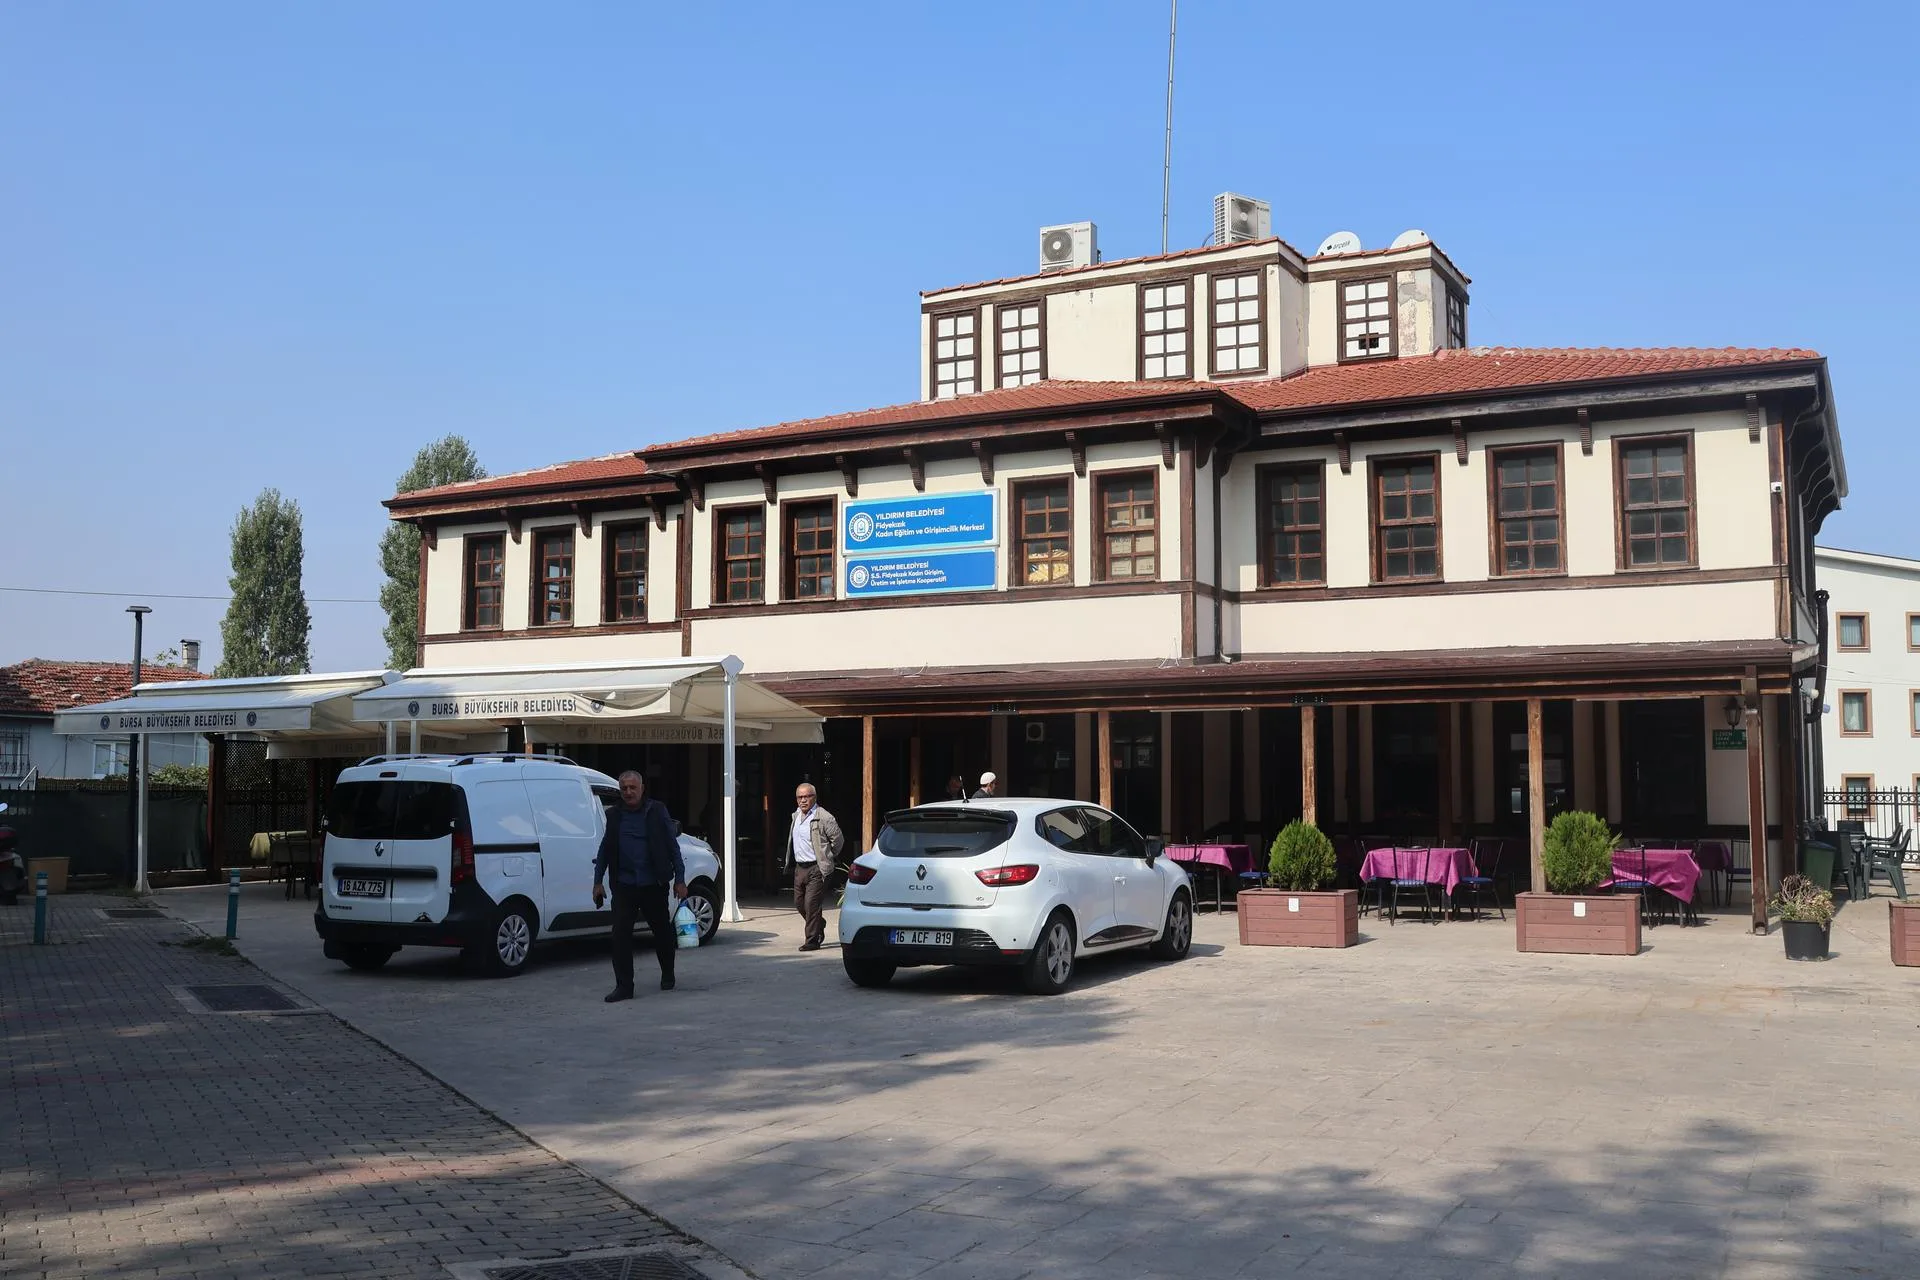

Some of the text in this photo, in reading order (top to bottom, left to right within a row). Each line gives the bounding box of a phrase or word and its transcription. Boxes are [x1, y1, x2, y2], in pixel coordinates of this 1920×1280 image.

[875, 507, 945, 520] YILDIRIM BELEDİYESİ
[875, 530, 894, 538] Kadın
[894, 529, 915, 538] Eğitim
[924, 525, 959, 535] Girişimcilik
[959, 523, 985, 531] Merkezi
[870, 561, 929, 572] YILDIRIM BELEDİYESİ
[432, 696, 577, 717] BURSA BÜYÜKŞEHİR BELEDİYESİ
[119, 717, 143, 729] BURSA
[194, 712, 237, 727] BELEDİYESİ
[343, 880, 383, 893] 16 AZK 775
[896, 931, 952, 944] 16 ACF 819
